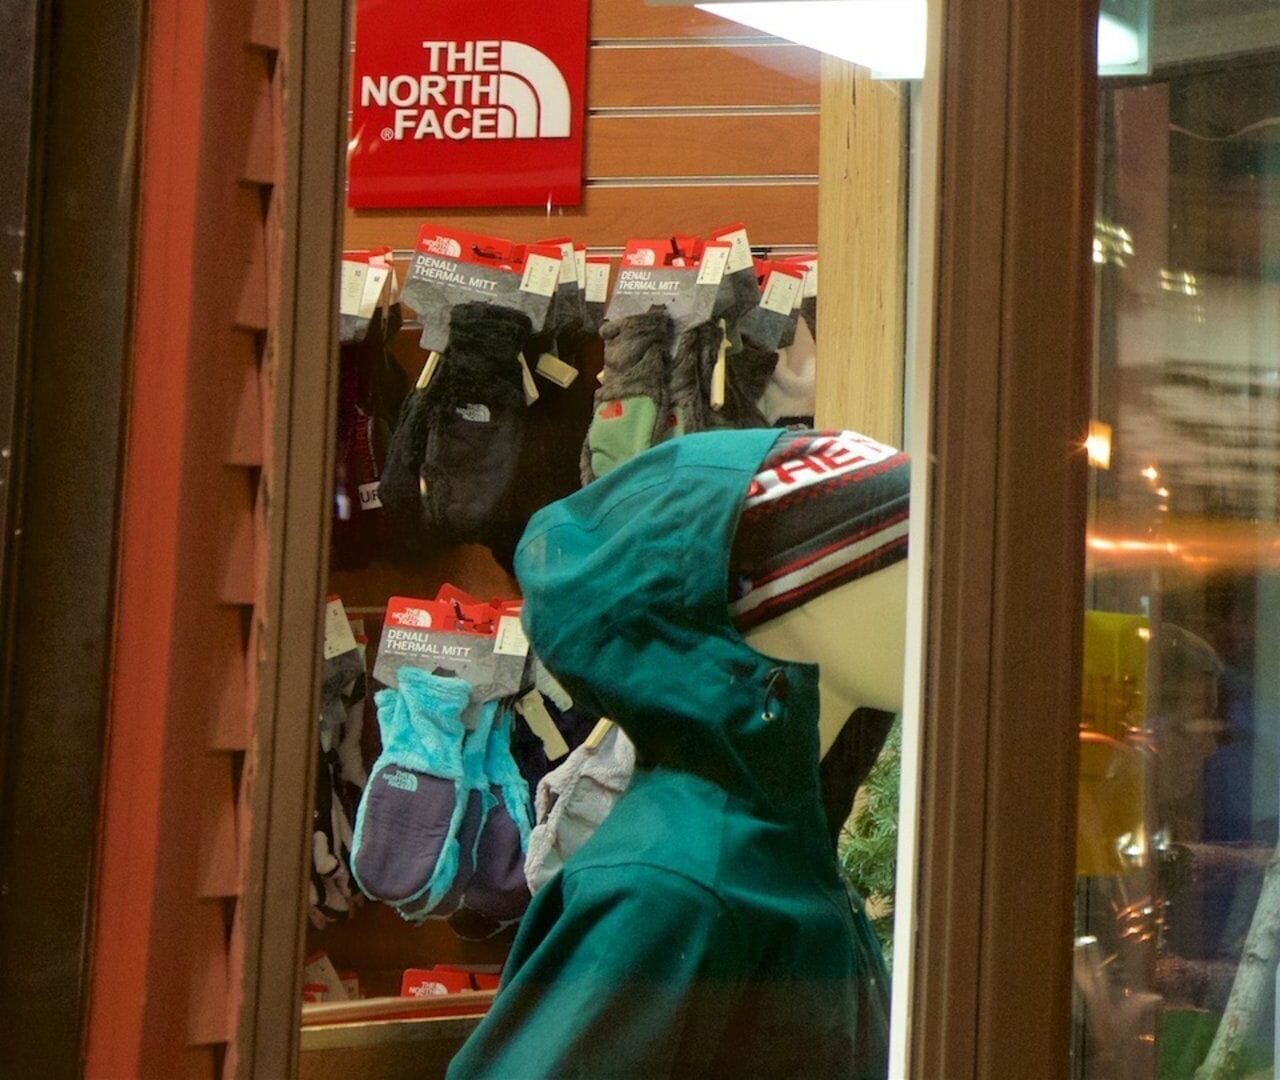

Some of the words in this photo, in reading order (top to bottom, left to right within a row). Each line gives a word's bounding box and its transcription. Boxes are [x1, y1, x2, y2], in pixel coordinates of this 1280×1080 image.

[422, 40, 500, 73] THE
[361, 74, 499, 108] NORTH
[394, 107, 498, 141] FACE
[416, 255, 457, 272] DENALI
[415, 264, 466, 285] THERMAL
[468, 276, 498, 291] MITT
[618, 280, 658, 291] THERMAL
[388, 629, 429, 642] DENALI
[386, 639, 440, 654] THERMAL
[441, 646, 472, 657] MITT
